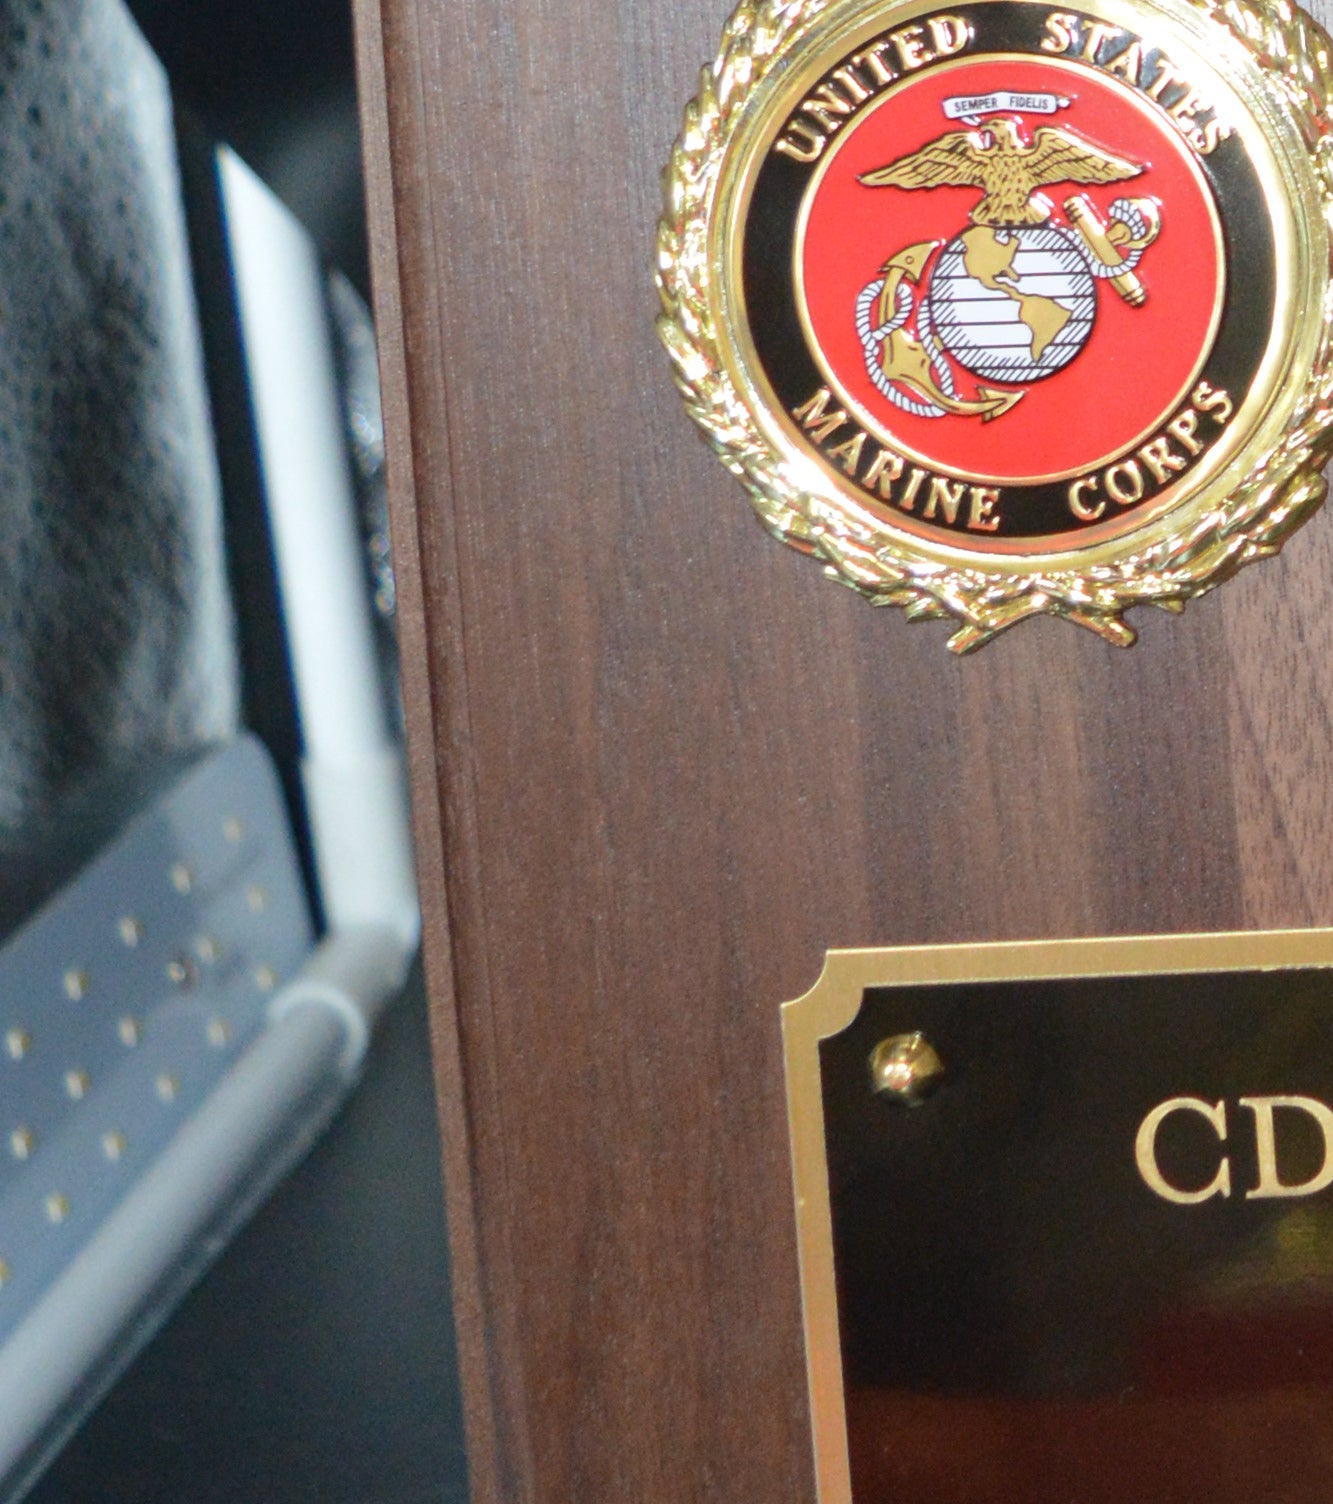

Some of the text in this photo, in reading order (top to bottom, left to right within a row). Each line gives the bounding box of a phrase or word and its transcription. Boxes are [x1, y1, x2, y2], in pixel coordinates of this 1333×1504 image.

[776, 11, 1237, 162] UNITED STATES
[953, 96, 1049, 113] SEMPER FIDELIS
[790, 382, 1232, 532] MARINE CORPS
